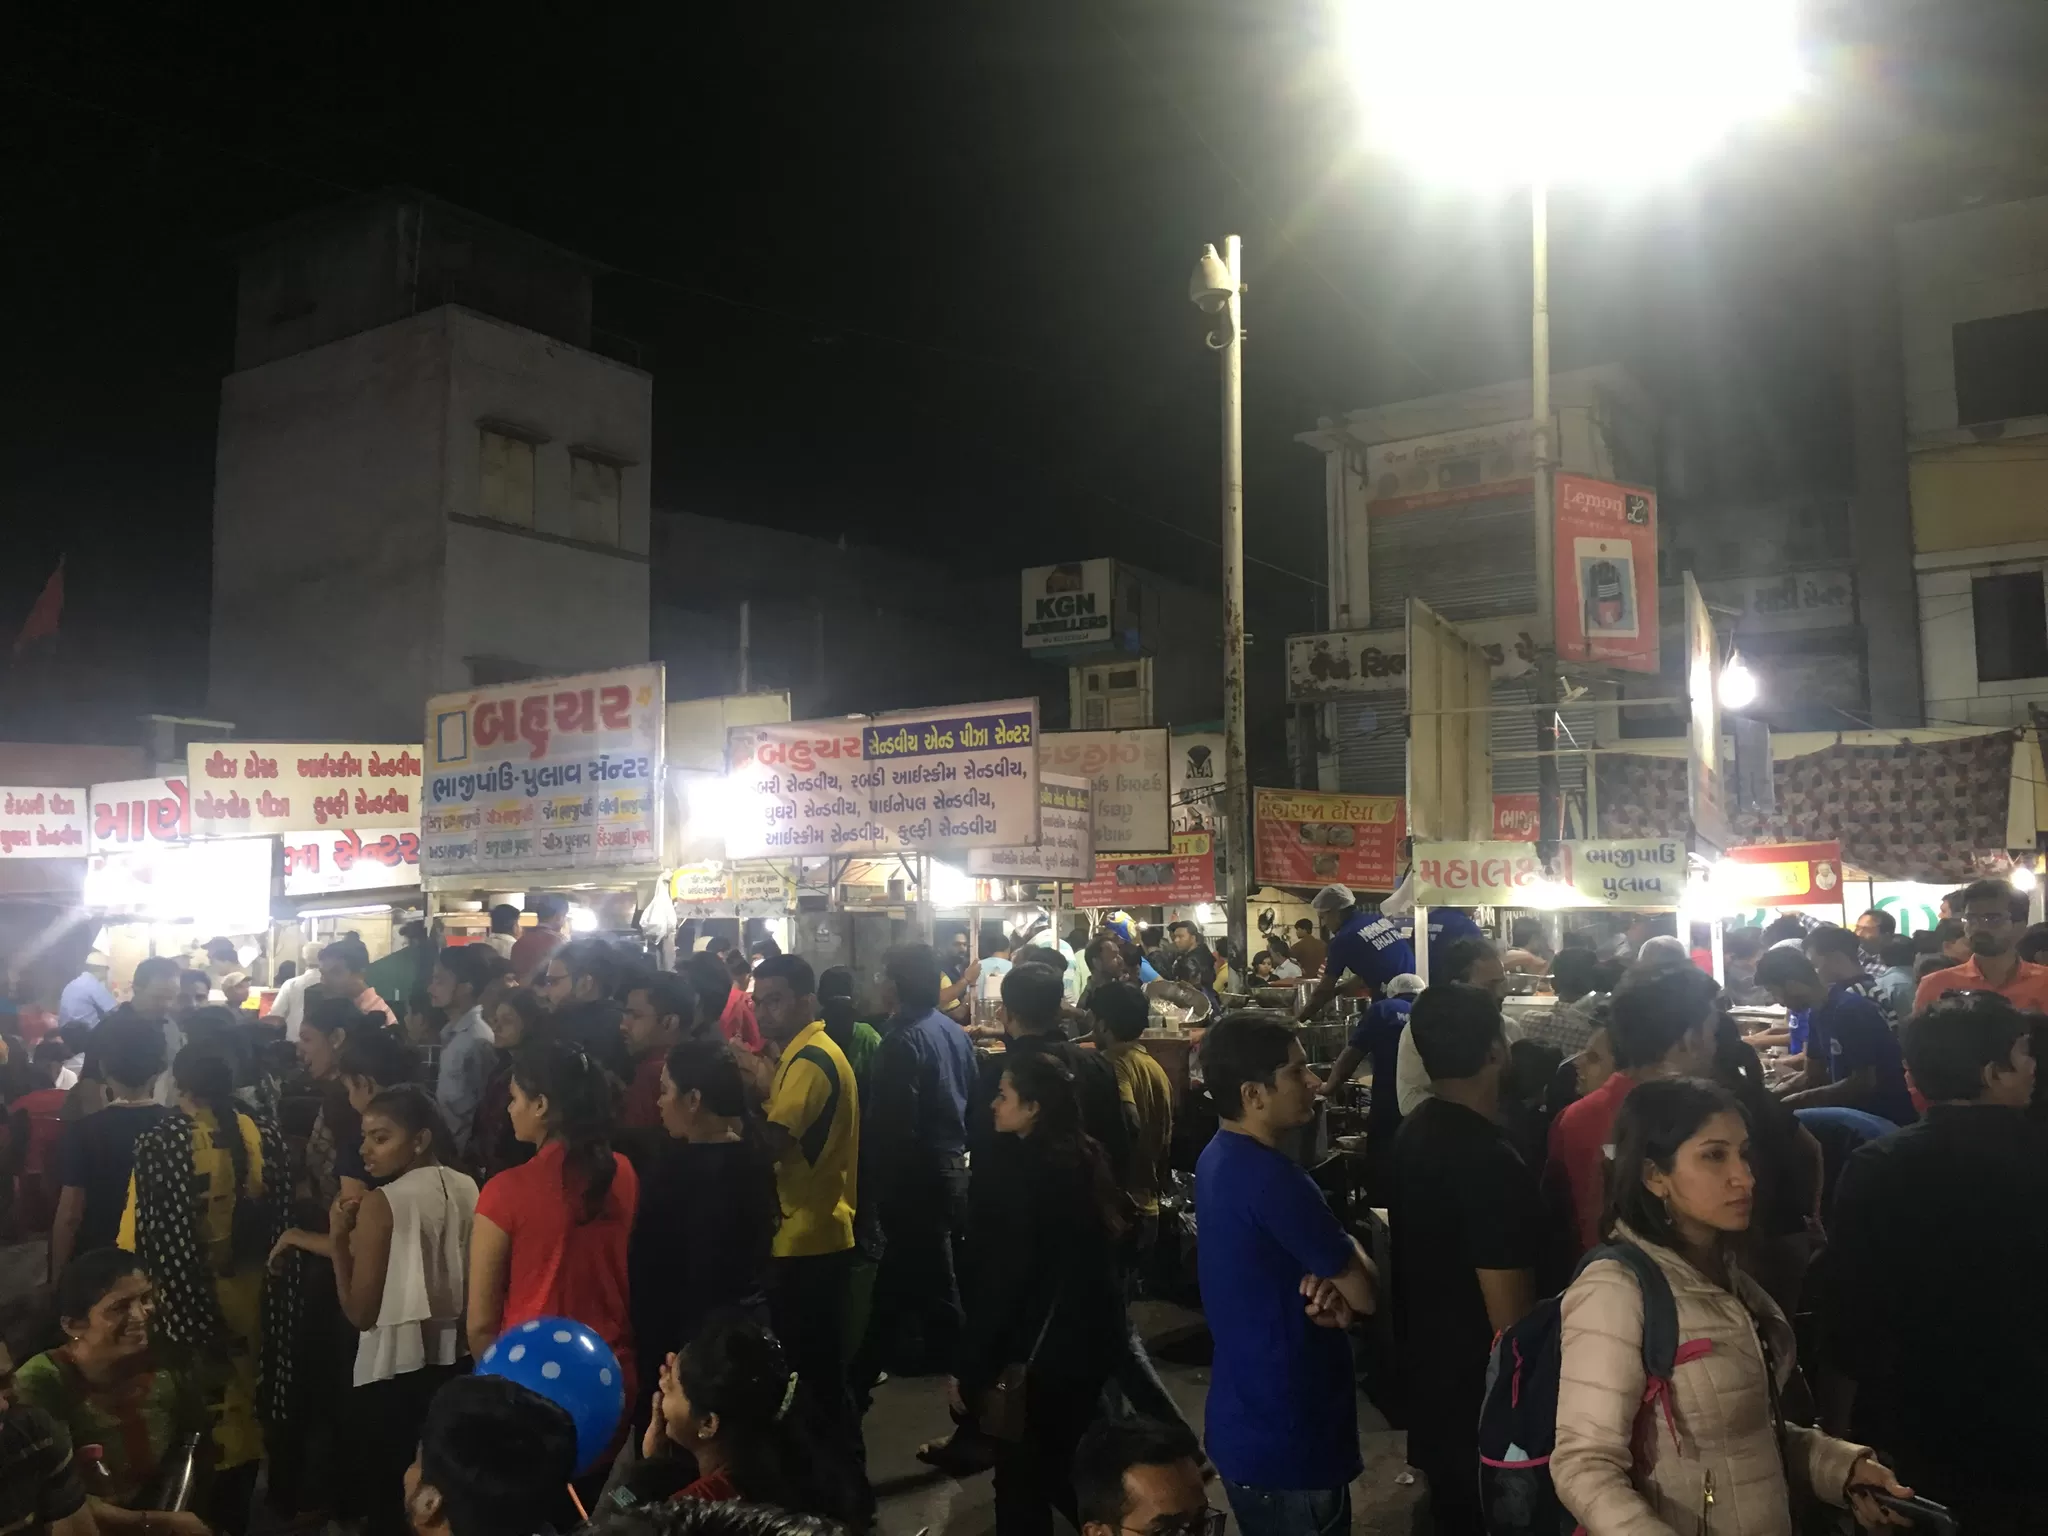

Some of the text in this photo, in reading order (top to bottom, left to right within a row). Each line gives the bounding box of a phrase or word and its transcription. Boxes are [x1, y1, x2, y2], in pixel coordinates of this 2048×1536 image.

[1564, 483, 1624, 520] Lemon
[1036, 593, 1095, 620] KGN
[473, 685, 632, 760] બહુચર
[868, 718, 1030, 756] સેન્ડવીચ એન્ડ પીઝા સેન્ટર
[758, 737, 860, 772] બહુચર
[787, 772, 843, 794] સેન્ડવીચ,
[851, 766, 885, 789] રબડી
[964, 760, 1027, 781] સેન્ડવીચ,
[804, 796, 861, 818] સેન્ડવીચ,
[869, 792, 926, 814] પાઈનેપલ
[934, 789, 995, 810] સેન્ડવીચ,
[565, 833, 591, 853] પુલાવ
[830, 822, 889, 844] સેન્ડવીચ,
[897, 818, 931, 846] કુલ્ફી
[938, 817, 996, 838] સેન્ડવીચ
[333, 828, 420, 871] સેન્ટર
[1602, 877, 1661, 900] પુલાવ
